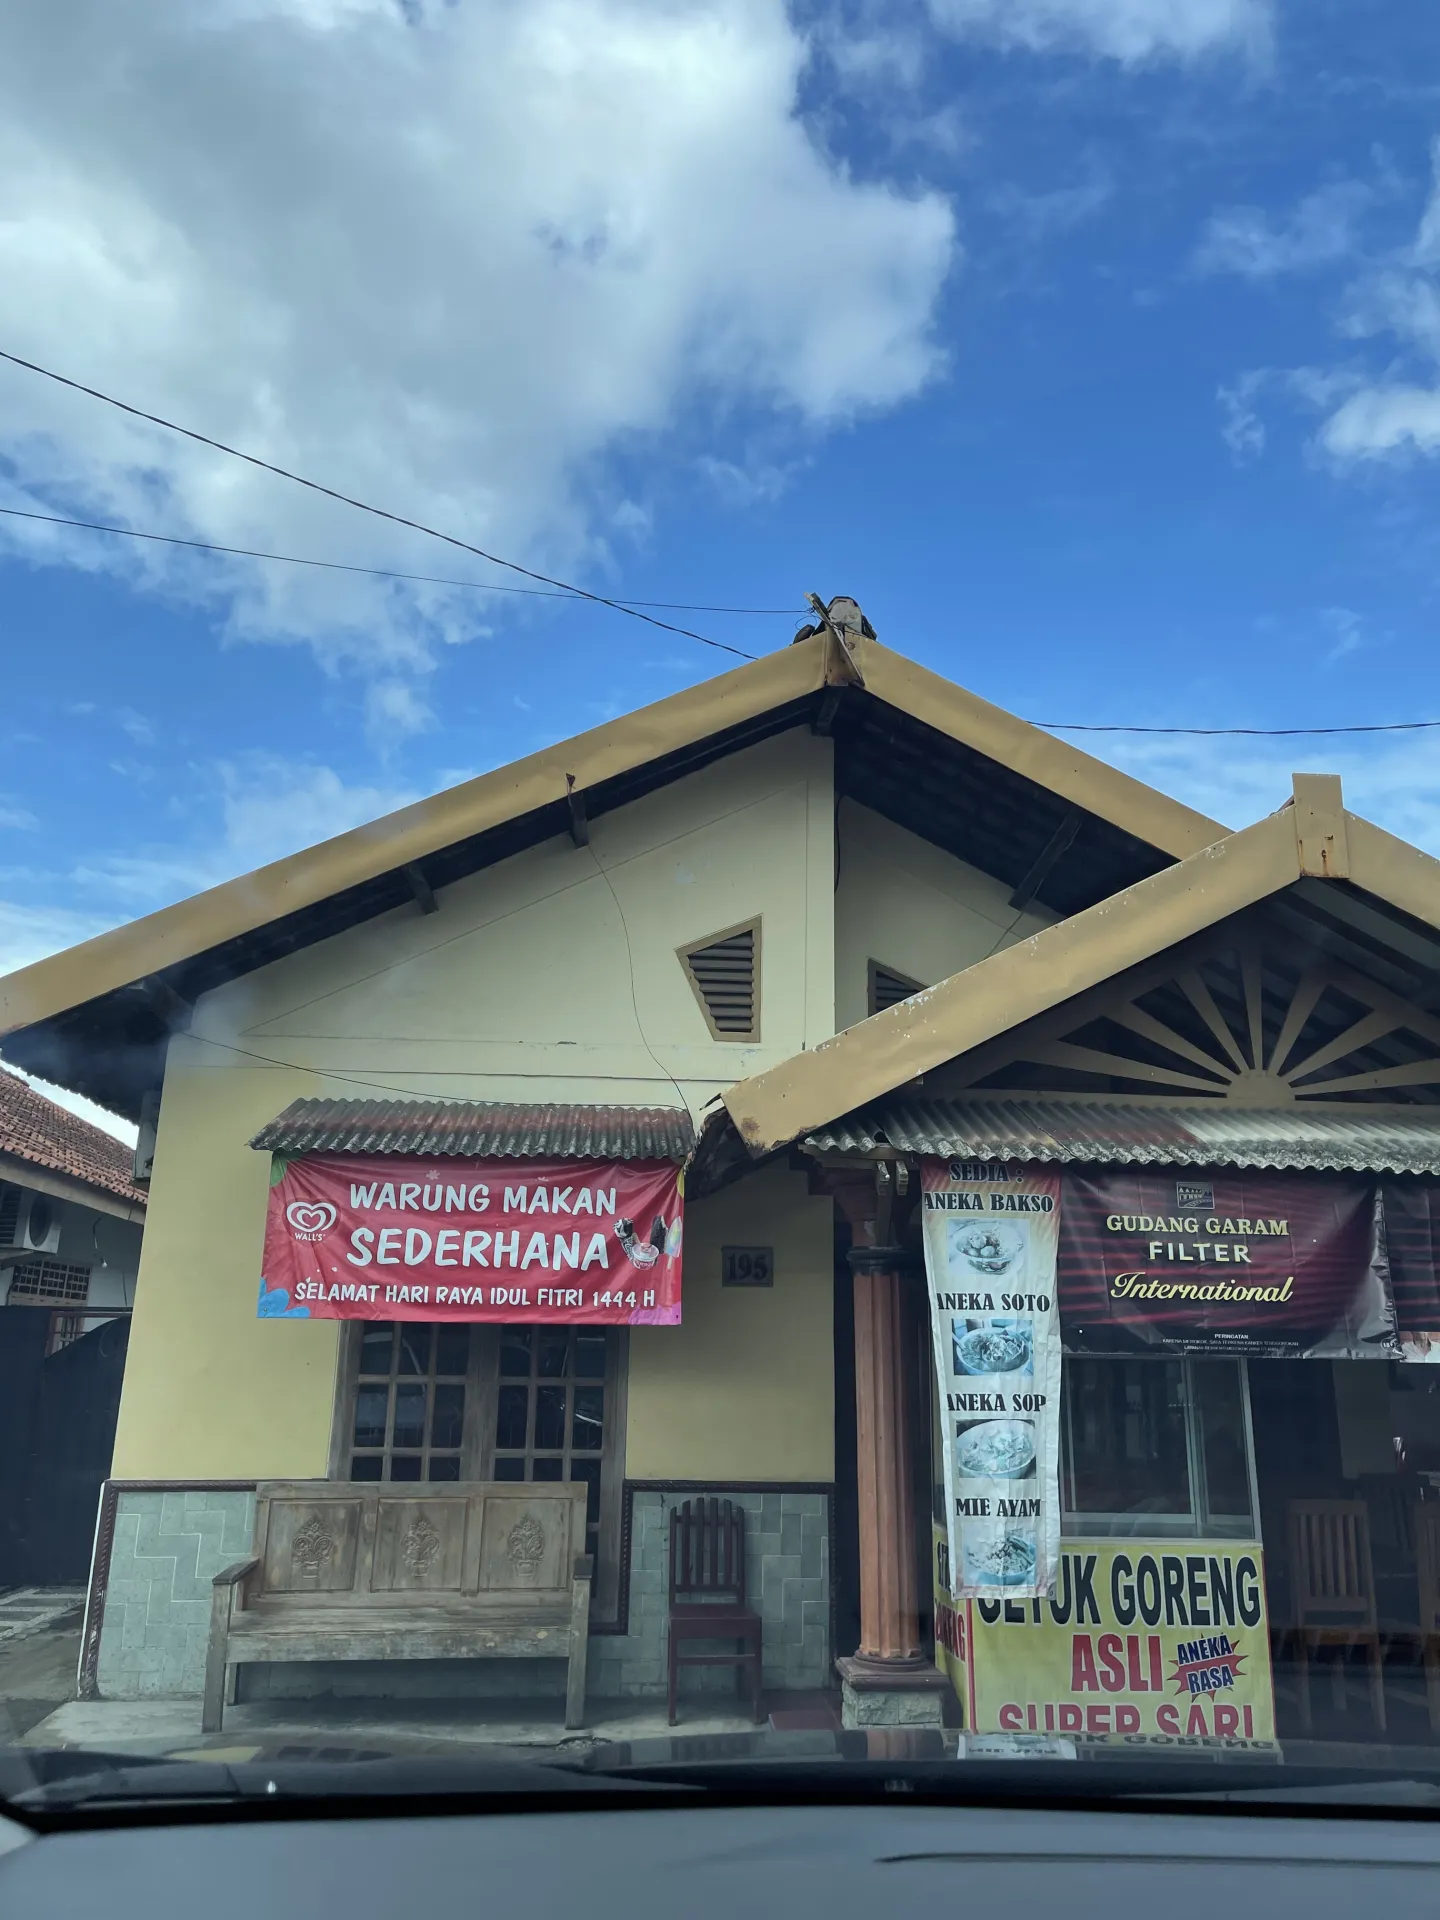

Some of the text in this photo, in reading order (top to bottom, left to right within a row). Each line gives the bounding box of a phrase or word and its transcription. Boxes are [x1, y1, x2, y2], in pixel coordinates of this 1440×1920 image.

[950, 1163, 1009, 1182] SEDIA
[350, 1182, 617, 1216] WARUNG MAKAN
[923, 1192, 1053, 1212] ANEKA BAKSO
[294, 1232, 323, 1241] WALL'S
[1106, 1215, 1289, 1236] GUDANG GARAM
[347, 1228, 610, 1271] SEDERHANA
[1149, 1241, 1252, 1263] FILTER
[728, 1252, 768, 1280] 195
[295, 1282, 656, 1308] SELAMAT HARI RAYA IDUL FITRI 1444 H
[1110, 1271, 1294, 1303] International
[1002, 1293, 1050, 1312] SOTO
[946, 1394, 1047, 1412] ANEKA SOP
[955, 1498, 1042, 1518] MIE AYAM
[1111, 1555, 1262, 1627] GORENG
[1177, 1634, 1233, 1664] ANEKA
[1071, 1634, 1164, 1692] ASLI
[1188, 1666, 1235, 1695] RASA
